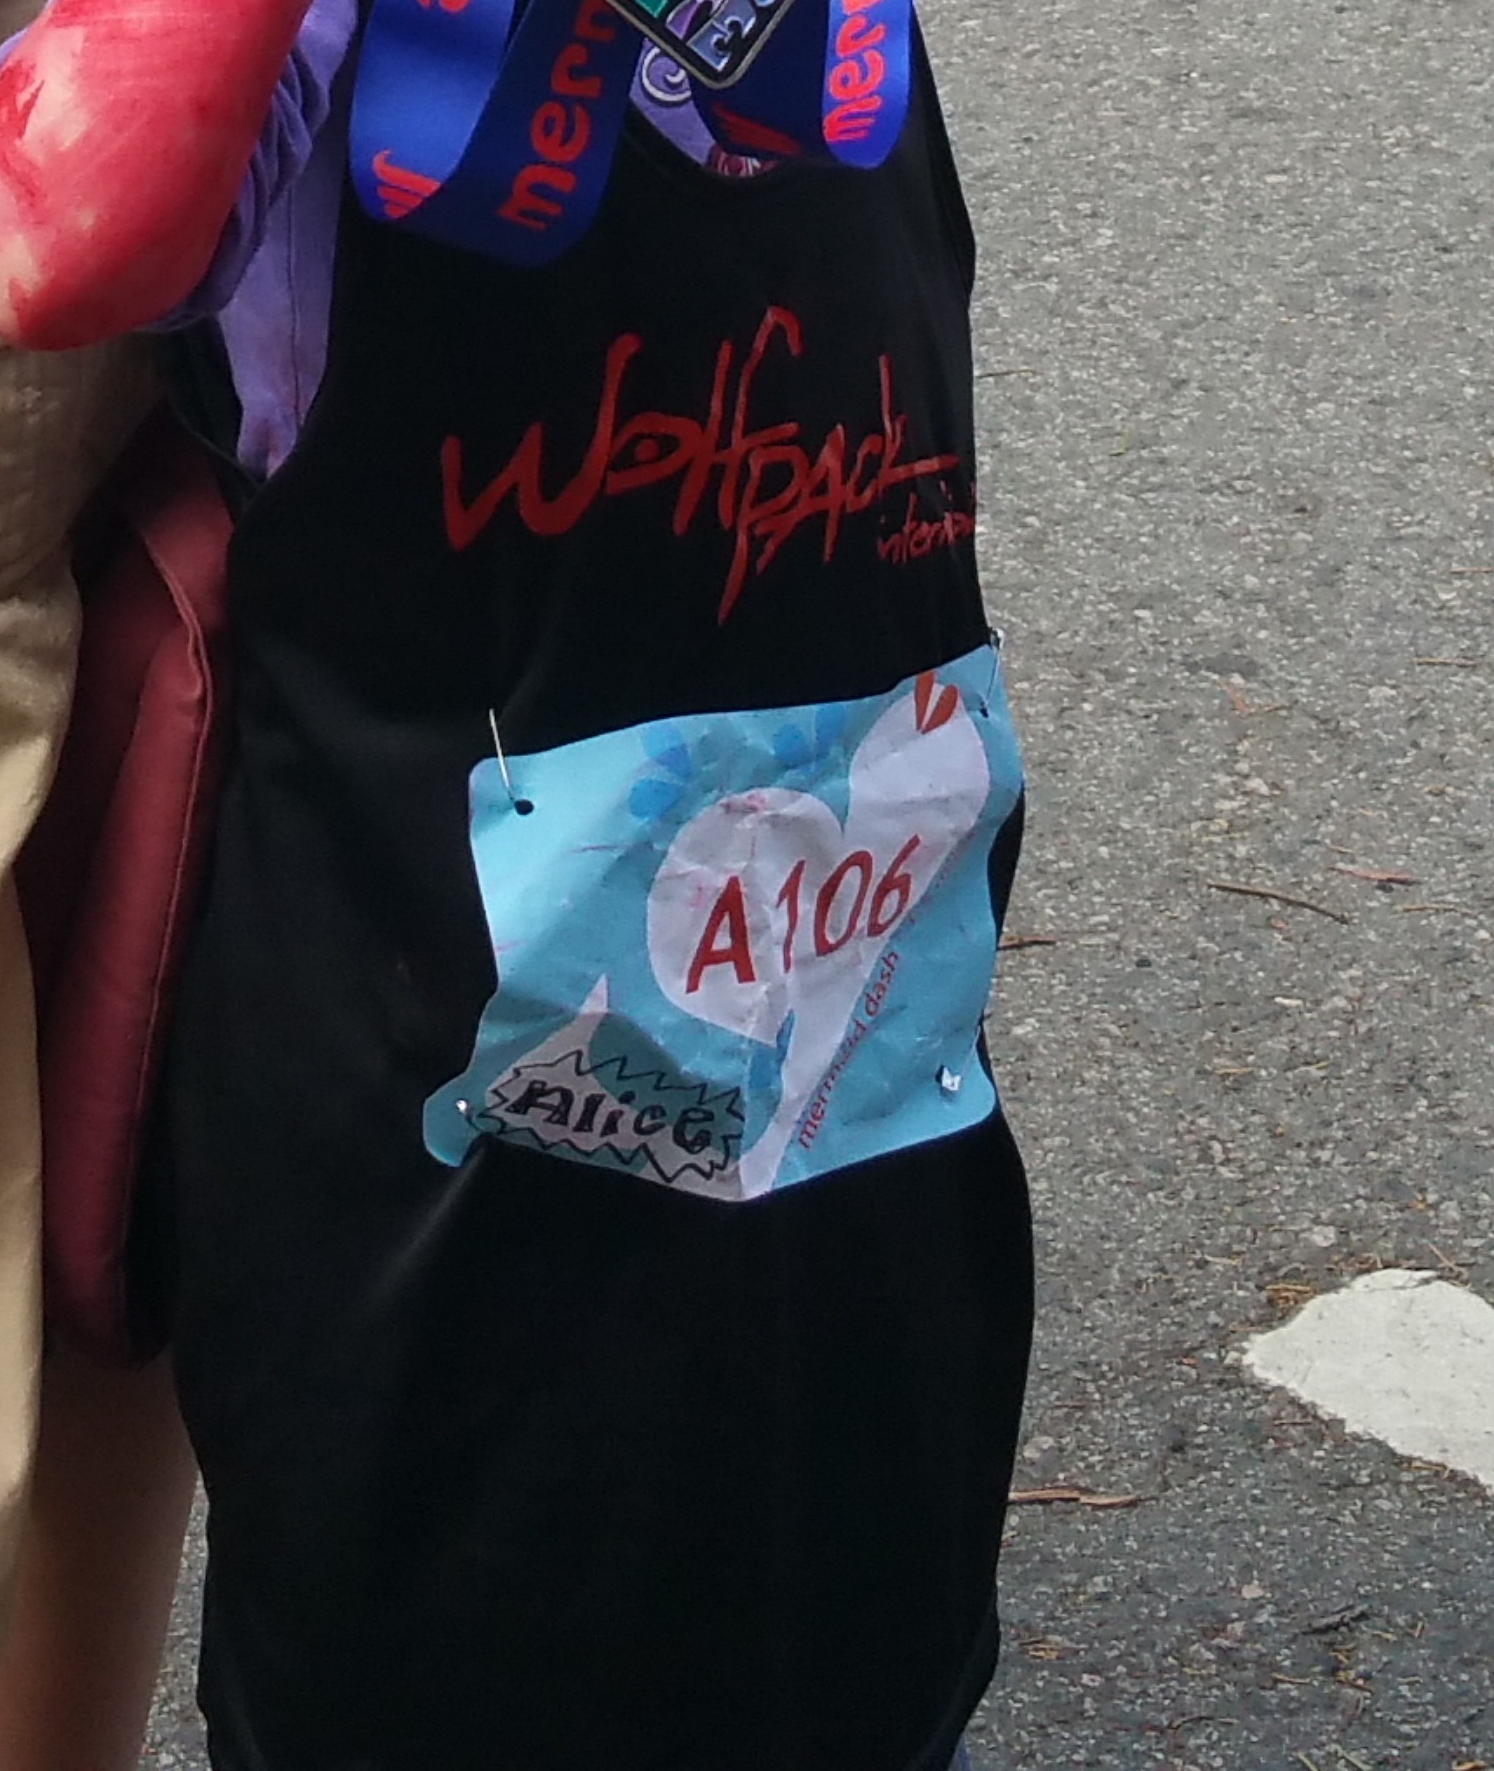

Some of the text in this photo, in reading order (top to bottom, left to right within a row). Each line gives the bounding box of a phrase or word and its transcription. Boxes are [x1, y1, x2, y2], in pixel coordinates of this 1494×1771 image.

[684, 834, 921, 995] A106
[863, 951, 900, 1018] dash
[505, 1079, 716, 1155] Alice
